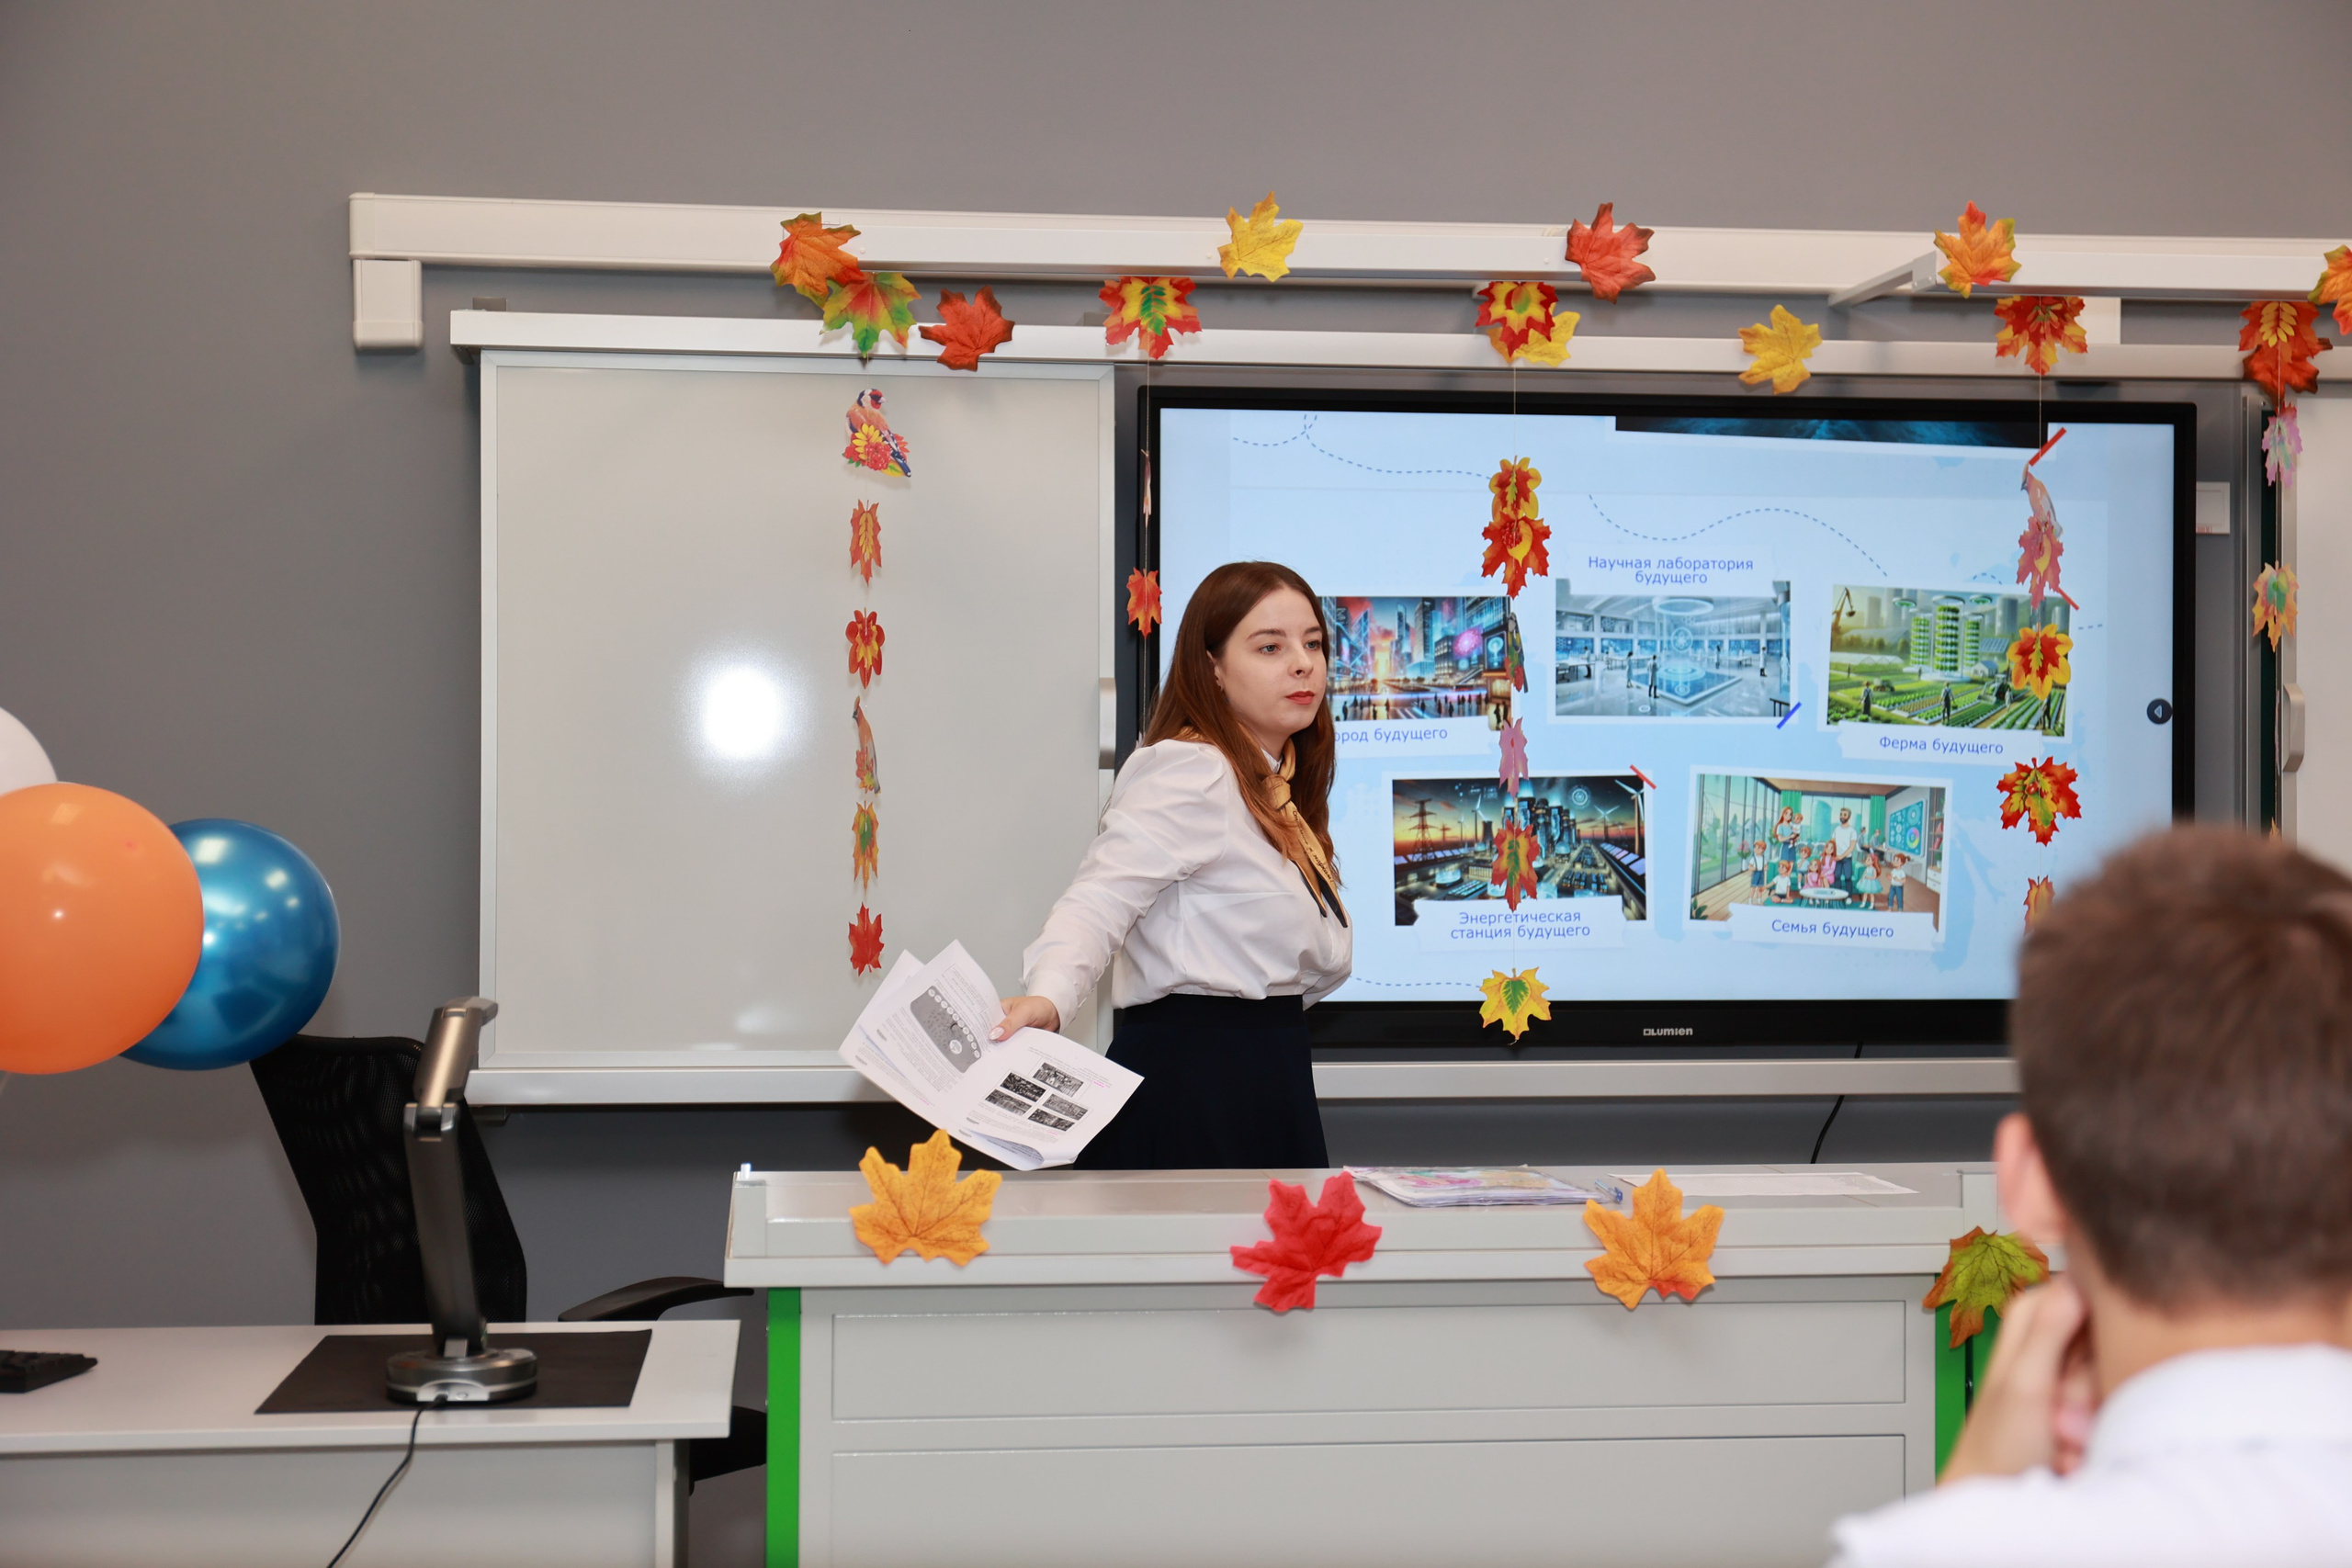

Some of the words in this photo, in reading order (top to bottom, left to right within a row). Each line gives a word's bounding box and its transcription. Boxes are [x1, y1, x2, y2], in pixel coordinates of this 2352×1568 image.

[1589, 556, 1652, 571] Научная
[1657, 557, 1754, 572] лаборатория
[1635, 570, 1708, 586] будущего
[1335, 731, 1369, 744] ород
[1374, 728, 1448, 742] будущего
[1880, 736, 1927, 751] Ферма
[1932, 738, 2004, 754] будущего
[1459, 911, 1581, 926] Энергетическая
[1451, 928, 1511, 940] станция
[1517, 924, 1591, 940] будущего
[1771, 919, 1817, 933] Семья
[1823, 921, 1894, 938] будущего
